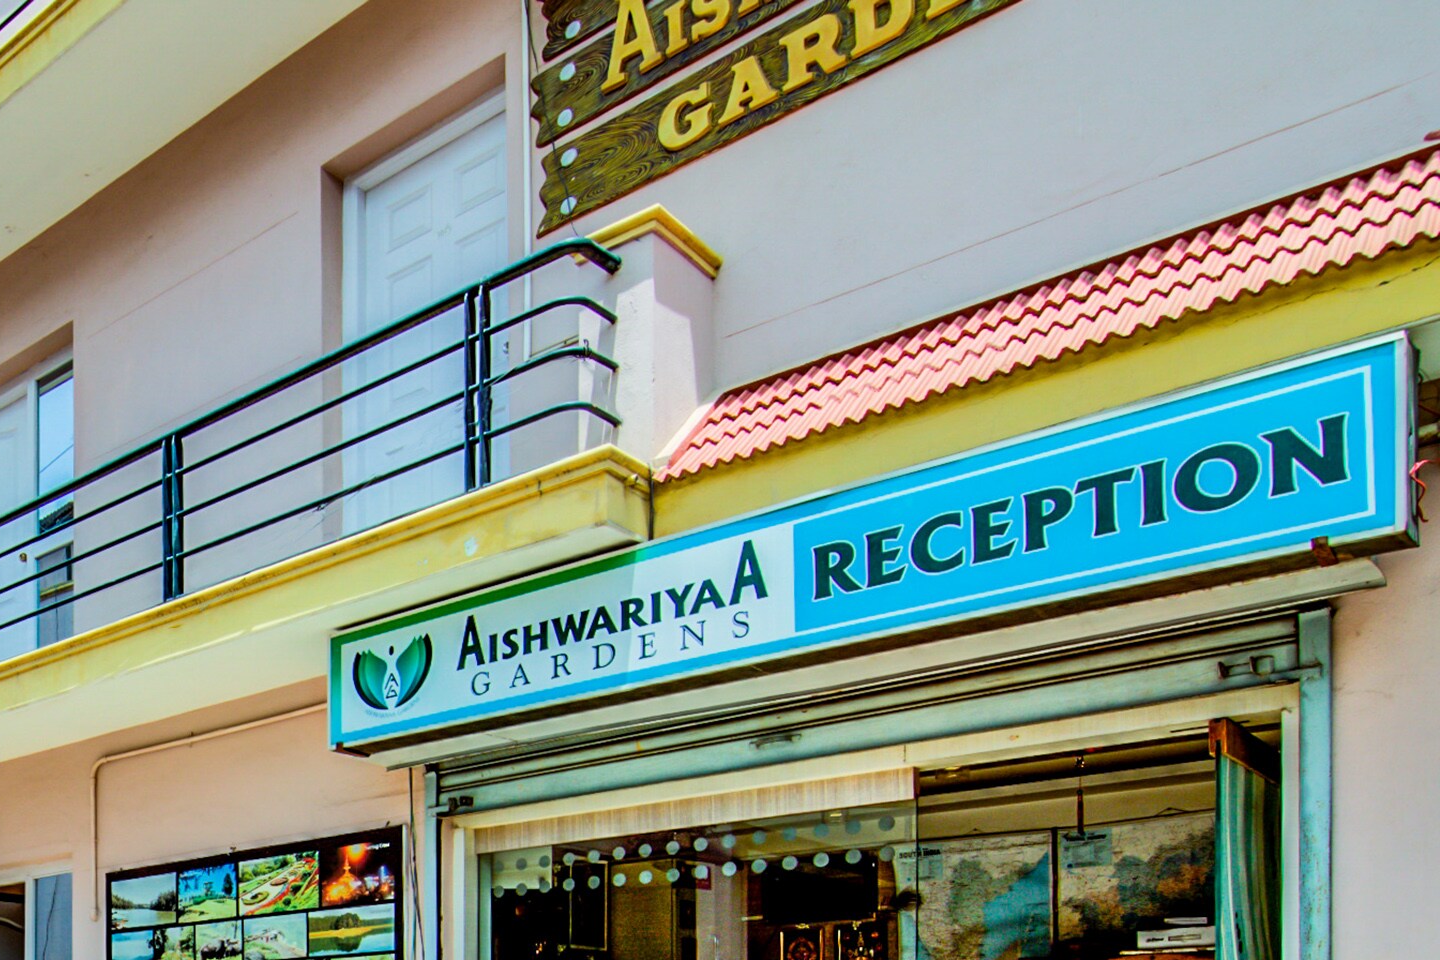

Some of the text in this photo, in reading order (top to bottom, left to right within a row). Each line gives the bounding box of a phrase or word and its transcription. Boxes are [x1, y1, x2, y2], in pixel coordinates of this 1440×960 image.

[601, 0, 772, 96] AIS
[658, 0, 962, 153] GARD
[811, 411, 1352, 602] RECEPTION
[456, 539, 769, 671] AISHWARIYAA
[471, 610, 751, 697] GARDENS
